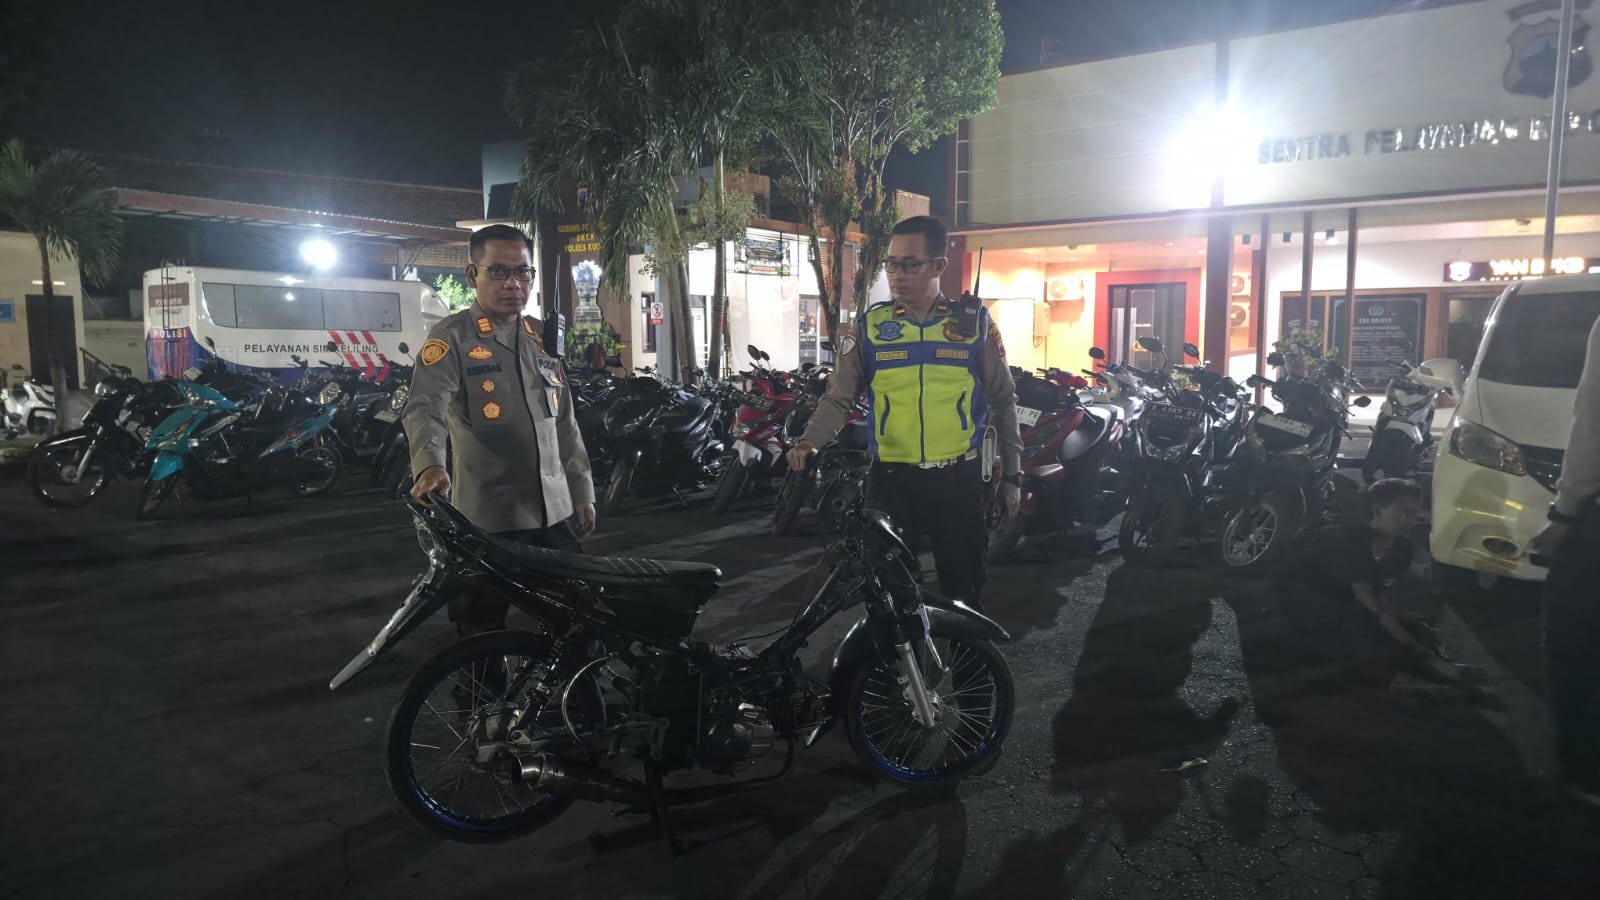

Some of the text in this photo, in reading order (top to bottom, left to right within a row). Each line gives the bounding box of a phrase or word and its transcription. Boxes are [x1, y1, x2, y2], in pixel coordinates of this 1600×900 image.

[1257, 134, 1351, 164] SENTRA
[153, 329, 188, 339] POLISI
[244, 344, 310, 353] PELAYANAN
